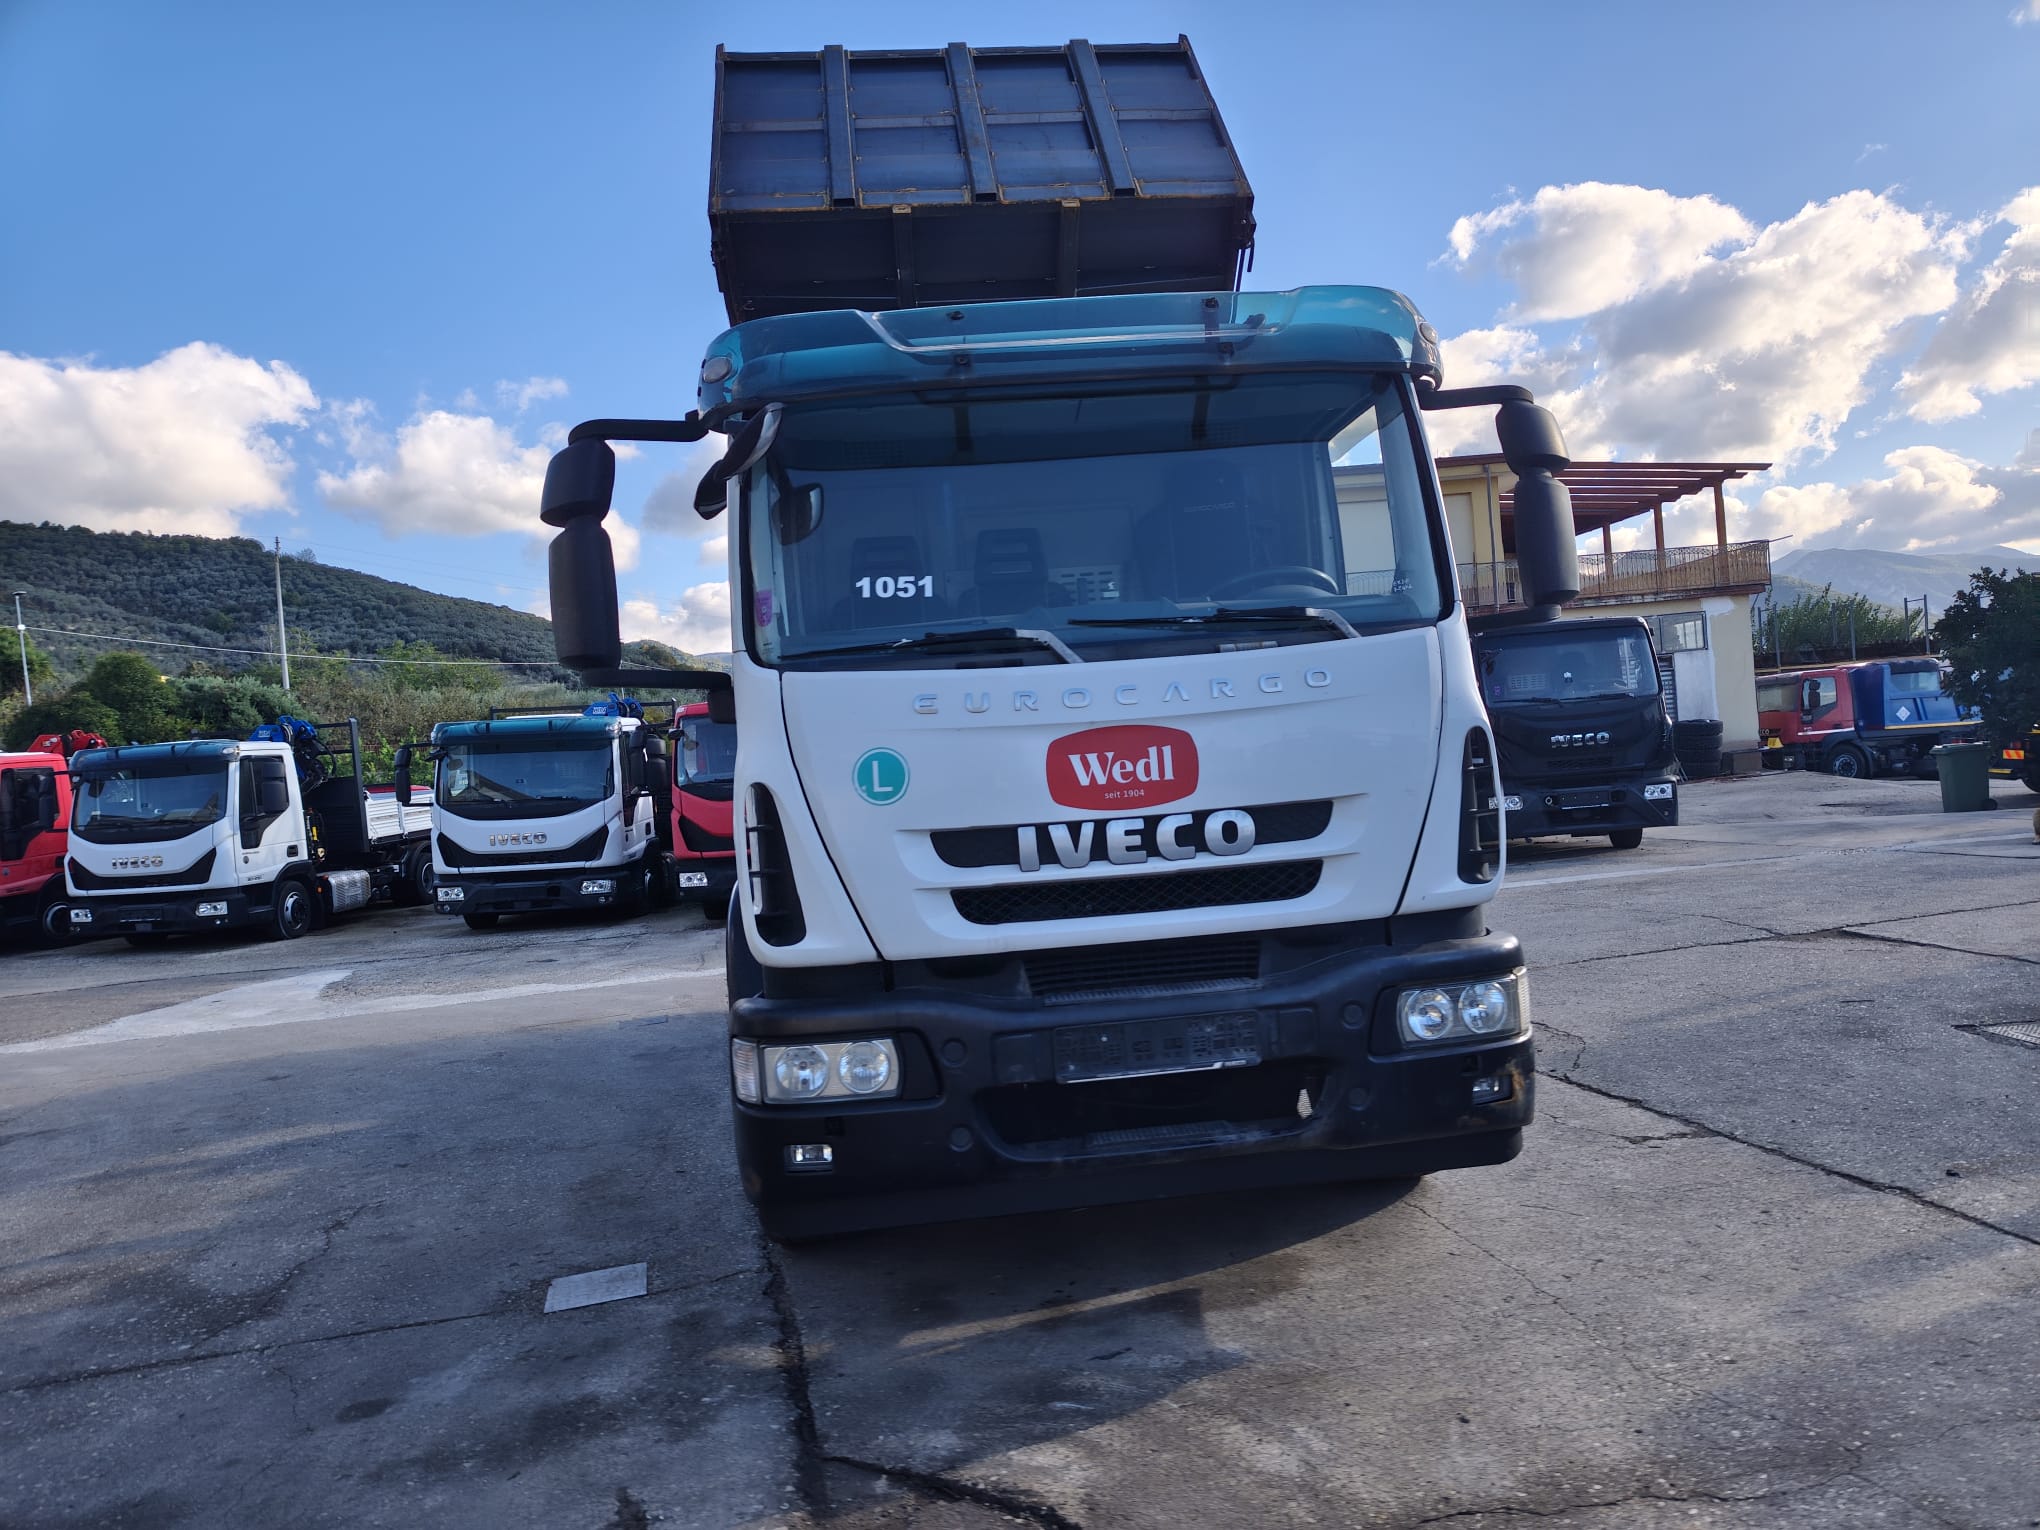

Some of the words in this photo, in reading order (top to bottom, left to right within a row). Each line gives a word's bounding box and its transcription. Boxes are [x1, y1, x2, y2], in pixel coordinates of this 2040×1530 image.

[855, 575, 933, 599] 1051
[912, 667, 1333, 715] EUROCARGO
[872, 760, 894, 792] L
[1067, 744, 1175, 787] Wedl
[1104, 789, 1121, 799] seit
[1123, 788, 1145, 799] 1904
[489, 831, 548, 847] IVECO
[1017, 808, 1257, 873] IVECO
[111, 855, 164, 870] IVECO
